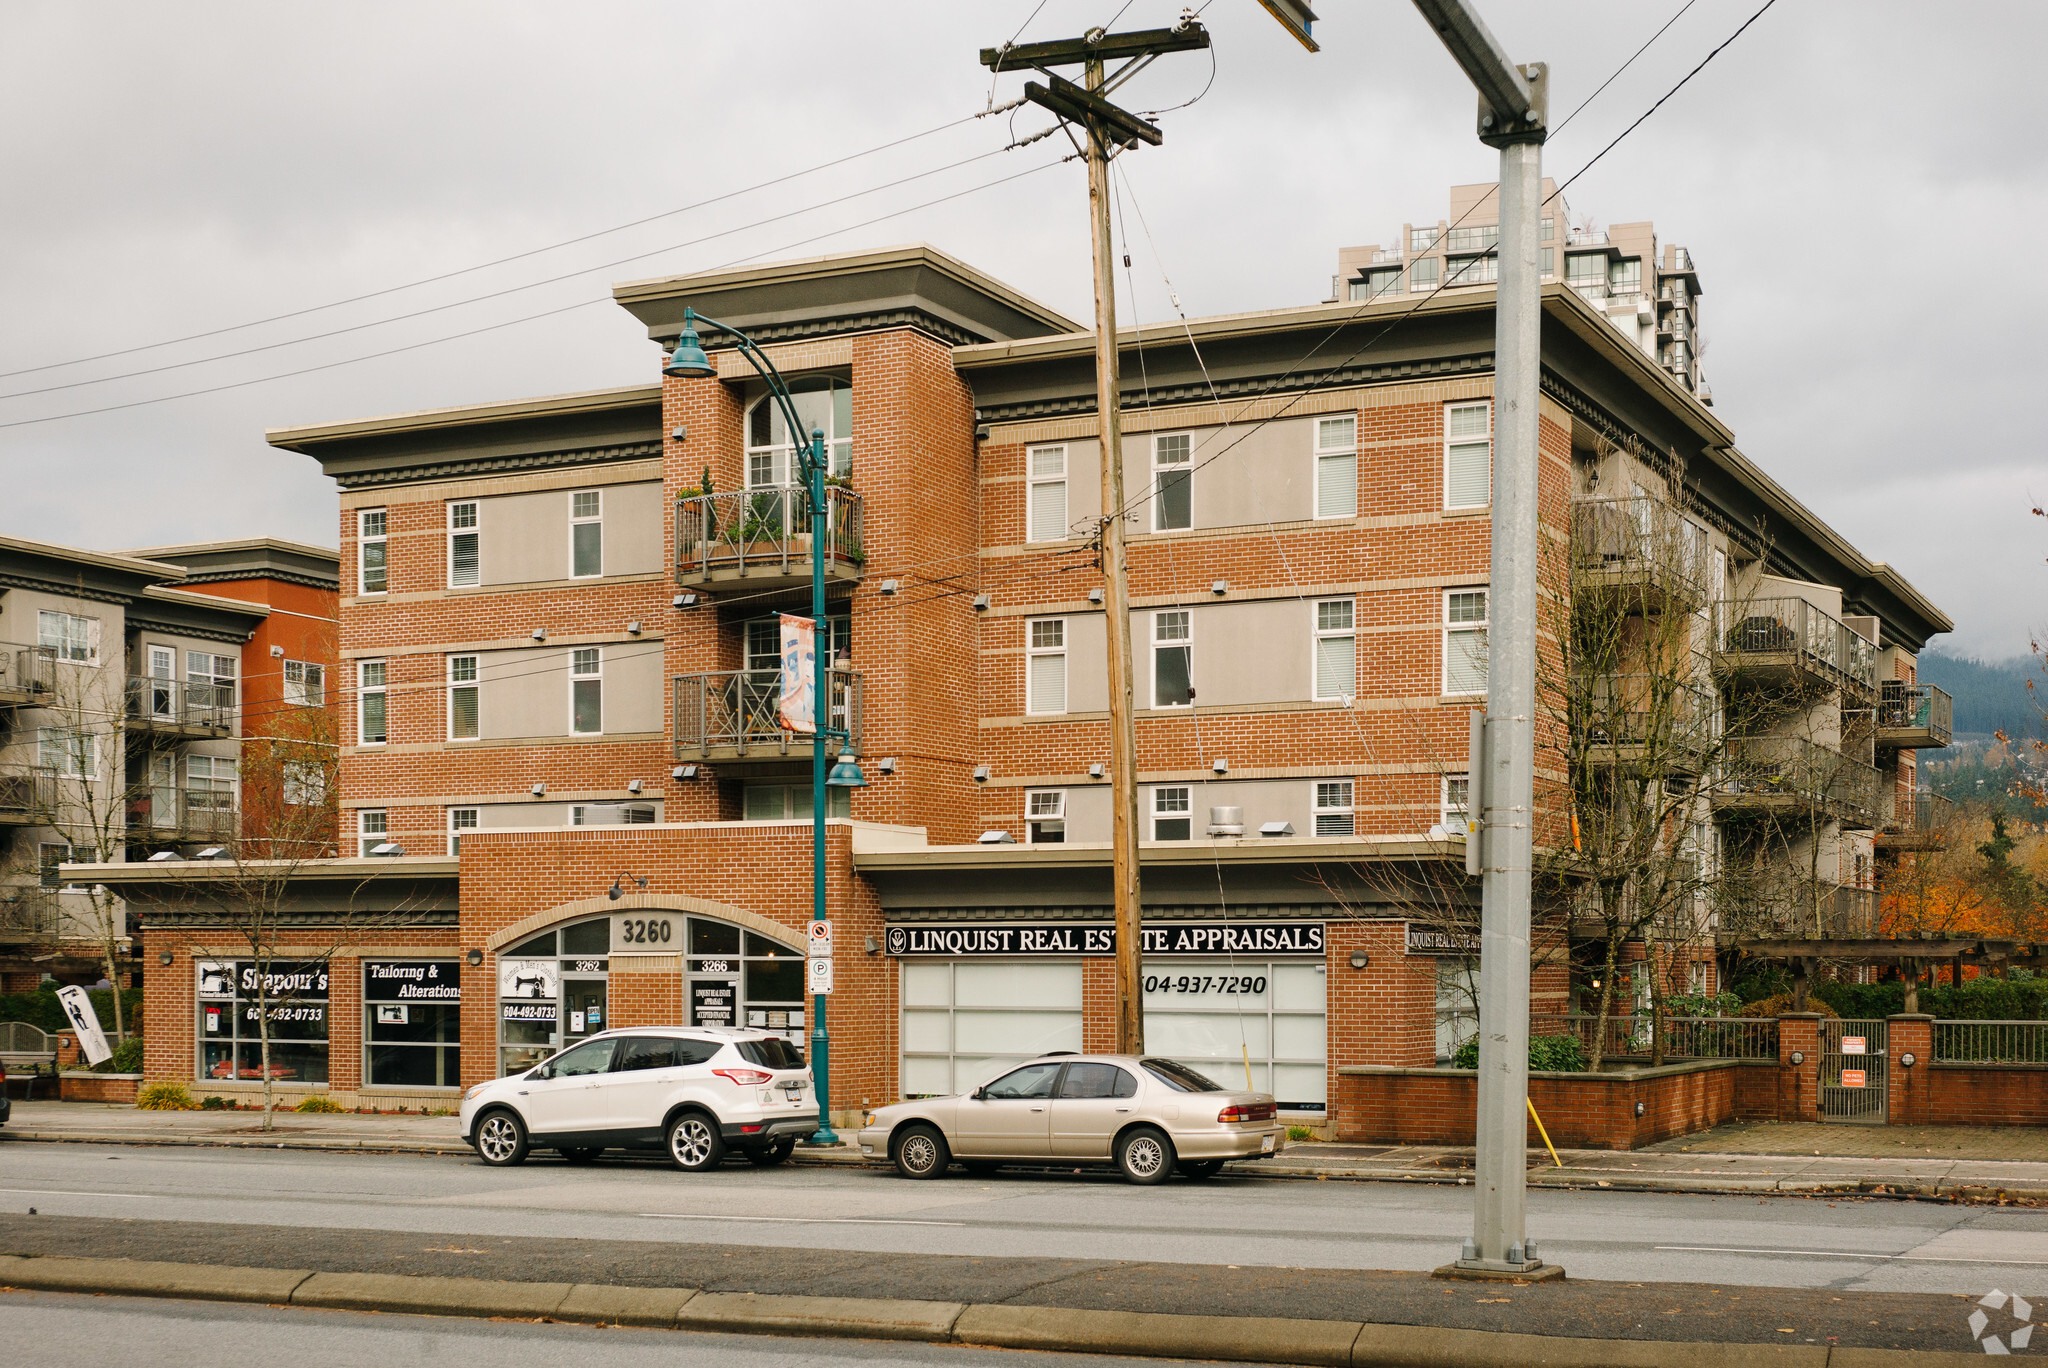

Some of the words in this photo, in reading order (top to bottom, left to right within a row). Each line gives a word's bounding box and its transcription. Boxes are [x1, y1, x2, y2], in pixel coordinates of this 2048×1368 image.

[623, 919, 671, 943] 3260
[909, 930, 1014, 954] LINQUIST
[1019, 930, 1079, 951] REAL
[1085, 929, 1169, 951] ESTE
[1174, 928, 1323, 950] APPRAISALS
[371, 964, 425, 981] Tailoring
[428, 964, 439, 978] &
[575, 960, 600, 972] 3262
[701, 960, 728, 972] 3266
[241, 967, 329, 995] Shapour's
[1141, 975, 1268, 994] 04-937-7290
[503, 1006, 556, 1018] 604-492-0733
